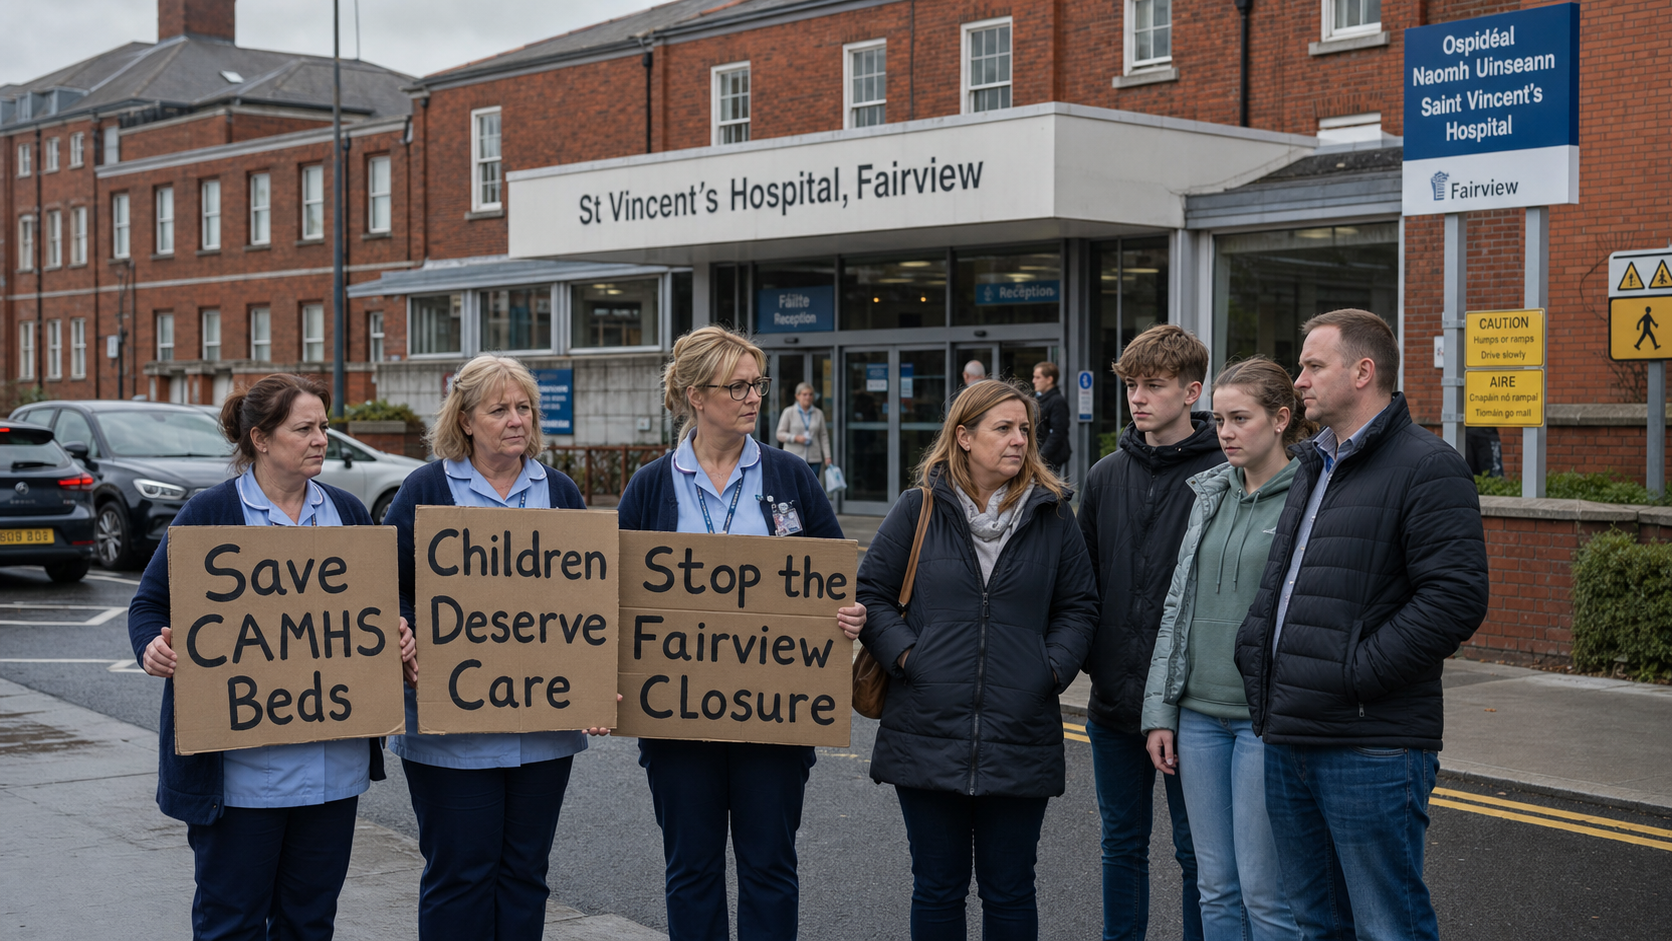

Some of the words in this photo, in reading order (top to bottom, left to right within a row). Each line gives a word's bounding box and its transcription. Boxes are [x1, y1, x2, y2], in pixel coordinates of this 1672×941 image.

[1443, 25, 1515, 57] Ospidéal
[1413, 61, 1470, 87] Naomh
[1476, 53, 1556, 78] Uinseann
[1421, 94, 1462, 117] Saint
[1467, 83, 1543, 110] Vincent's
[1446, 114, 1513, 143] Hospital
[579, 194, 602, 225] St
[609, 182, 718, 222] Vincent's
[730, 167, 849, 216] Hospital,
[857, 156, 984, 200] Fairview
[1451, 178, 1519, 200] Fairview
[778, 293, 810, 308] Fáilte
[999, 284, 1054, 301] Reception
[774, 312, 817, 328] Reception
[1479, 316, 1529, 330] CAUTION
[1473, 336, 1499, 345] Humps
[1510, 335, 1535, 345] ramps
[1481, 350, 1501, 360] Drive
[1502, 350, 1527, 361] slowly
[1489, 376, 1516, 388] AIRE
[1505, 409, 1514, 419] go
[1516, 408, 1532, 417] mall
[427, 527, 608, 581] Children
[205, 544, 349, 602] Save
[642, 545, 762, 609] Stop
[777, 554, 848, 601] the
[430, 595, 607, 646] Deserve
[186, 607, 387, 668] CAMHS
[633, 615, 834, 668] Fairview
[227, 670, 353, 732] Beds
[448, 658, 571, 711] Care
